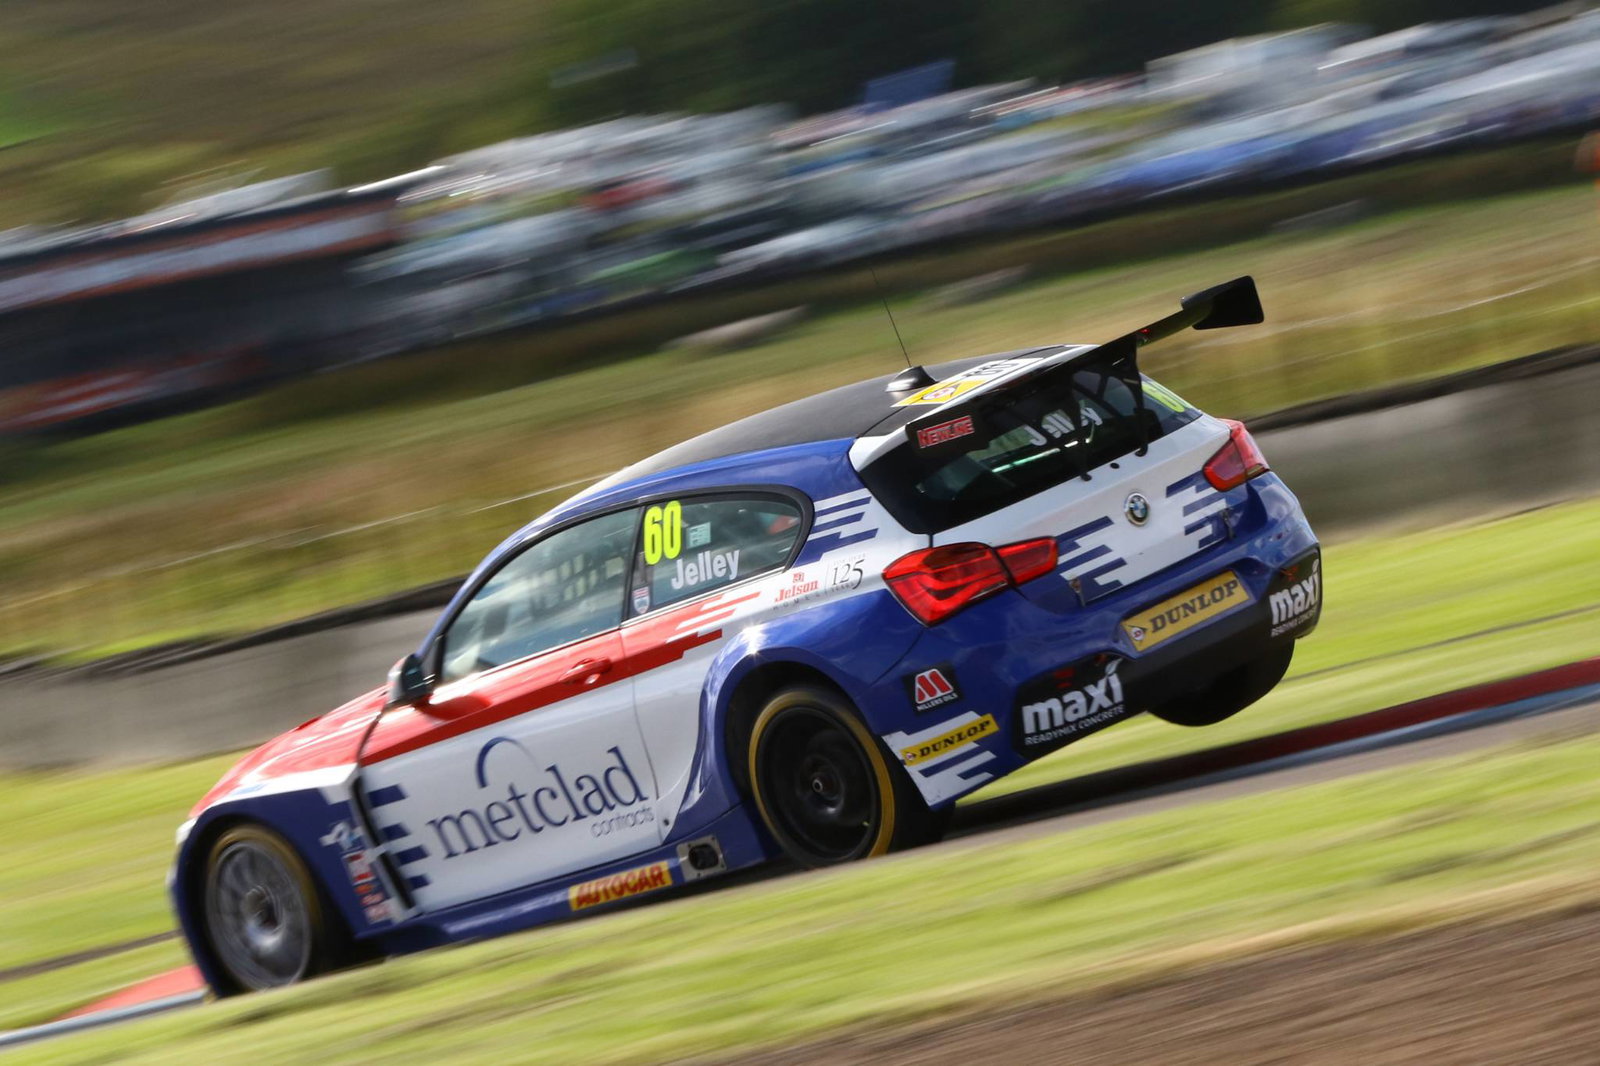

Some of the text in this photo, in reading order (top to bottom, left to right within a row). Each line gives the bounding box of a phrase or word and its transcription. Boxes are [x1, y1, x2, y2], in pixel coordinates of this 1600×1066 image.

[644, 500, 681, 565] 60
[671, 550, 739, 589] Jelley
[833, 559, 865, 590] 125
[775, 580, 819, 602] Jelson
[1149, 579, 1238, 633] DUNLOP
[1022, 659, 1123, 734] maxi
[918, 720, 990, 757] DUNLOP
[1024, 724, 1077, 745] READYMIX
[426, 745, 648, 860] metclad
[591, 806, 655, 838] contracts
[576, 864, 667, 908] AUTOCAR
